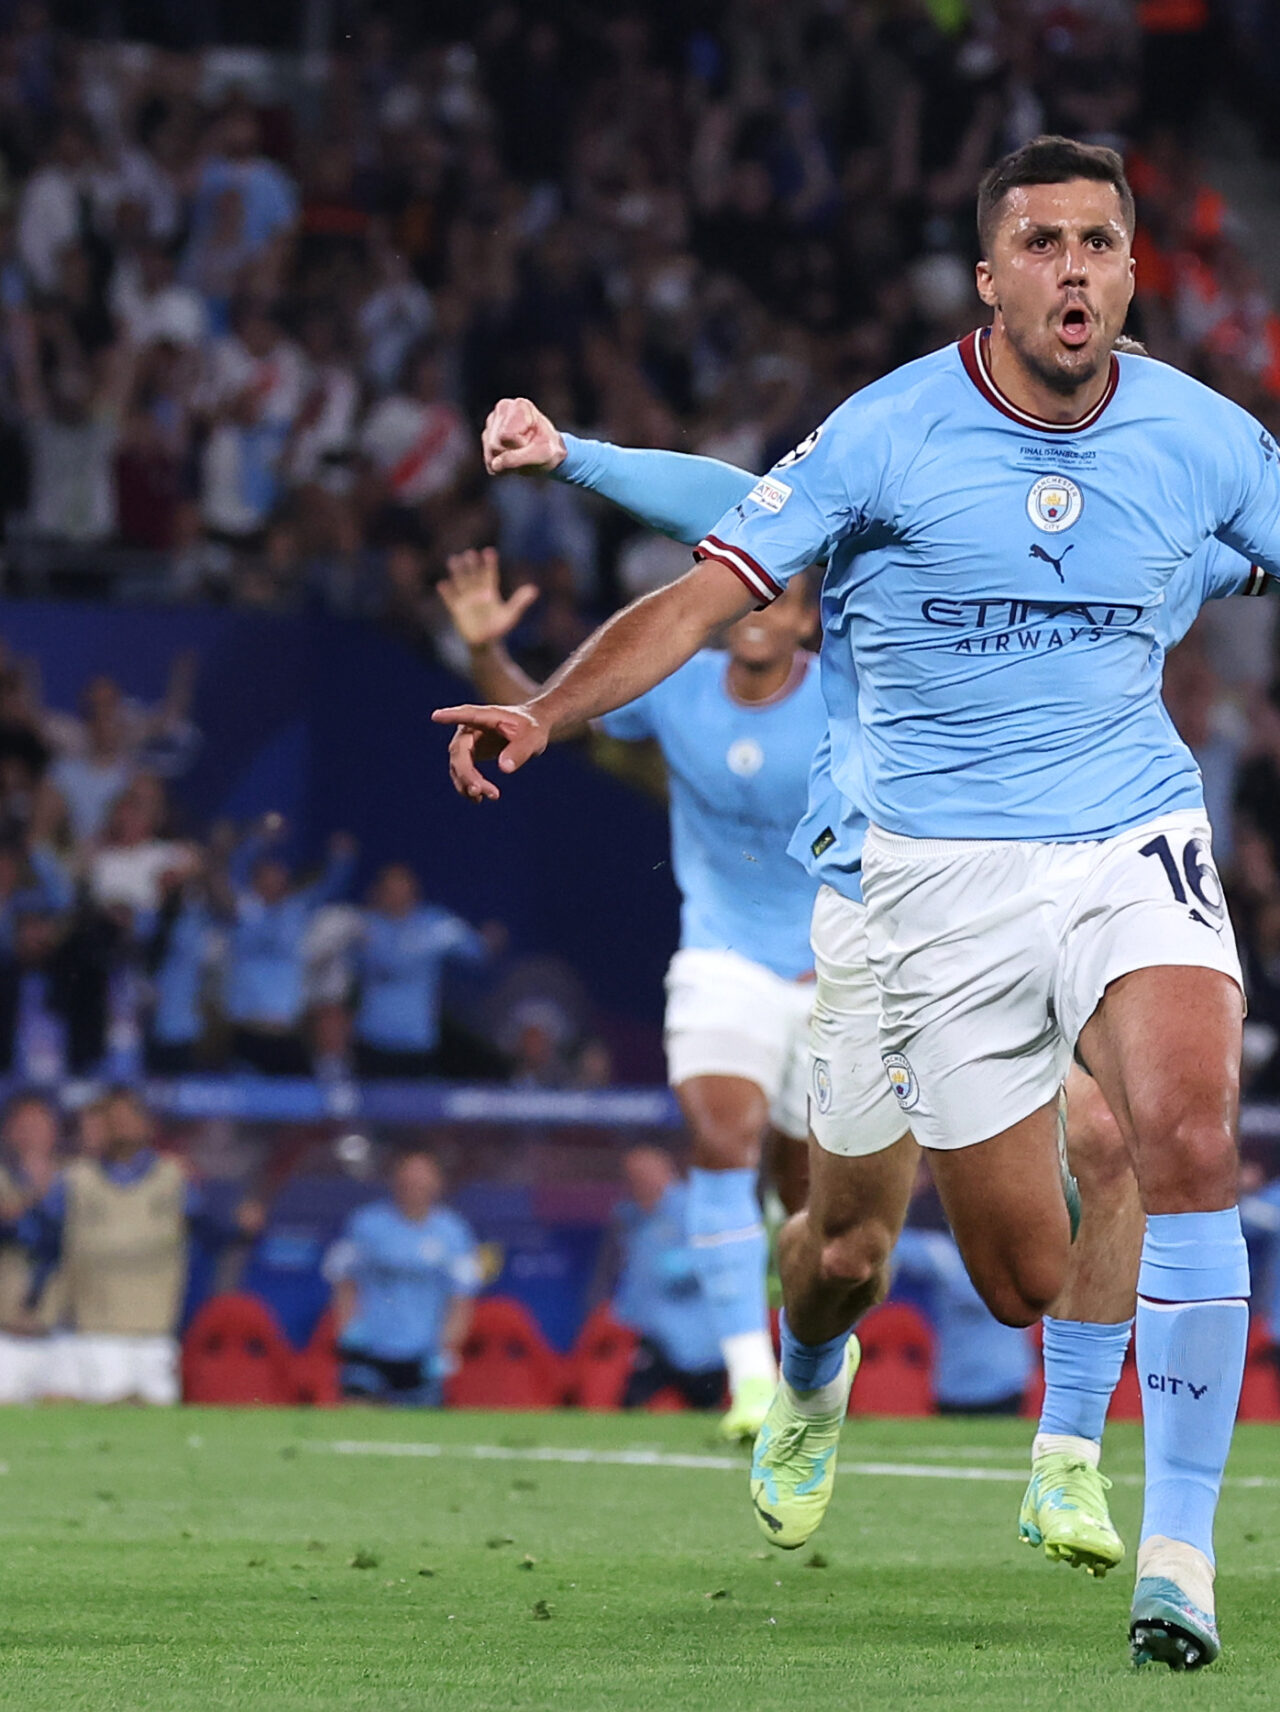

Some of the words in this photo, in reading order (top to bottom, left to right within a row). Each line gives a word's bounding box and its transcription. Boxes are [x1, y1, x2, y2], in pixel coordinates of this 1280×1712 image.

[1020, 446, 1043, 456] FINAL
[1032, 478, 1078, 498] MANCHESTER
[1043, 523, 1061, 531] CITY
[955, 627, 1104, 653] AIRWAYS
[1138, 834, 1225, 920] 16
[1147, 1373, 1208, 1400] CITY
